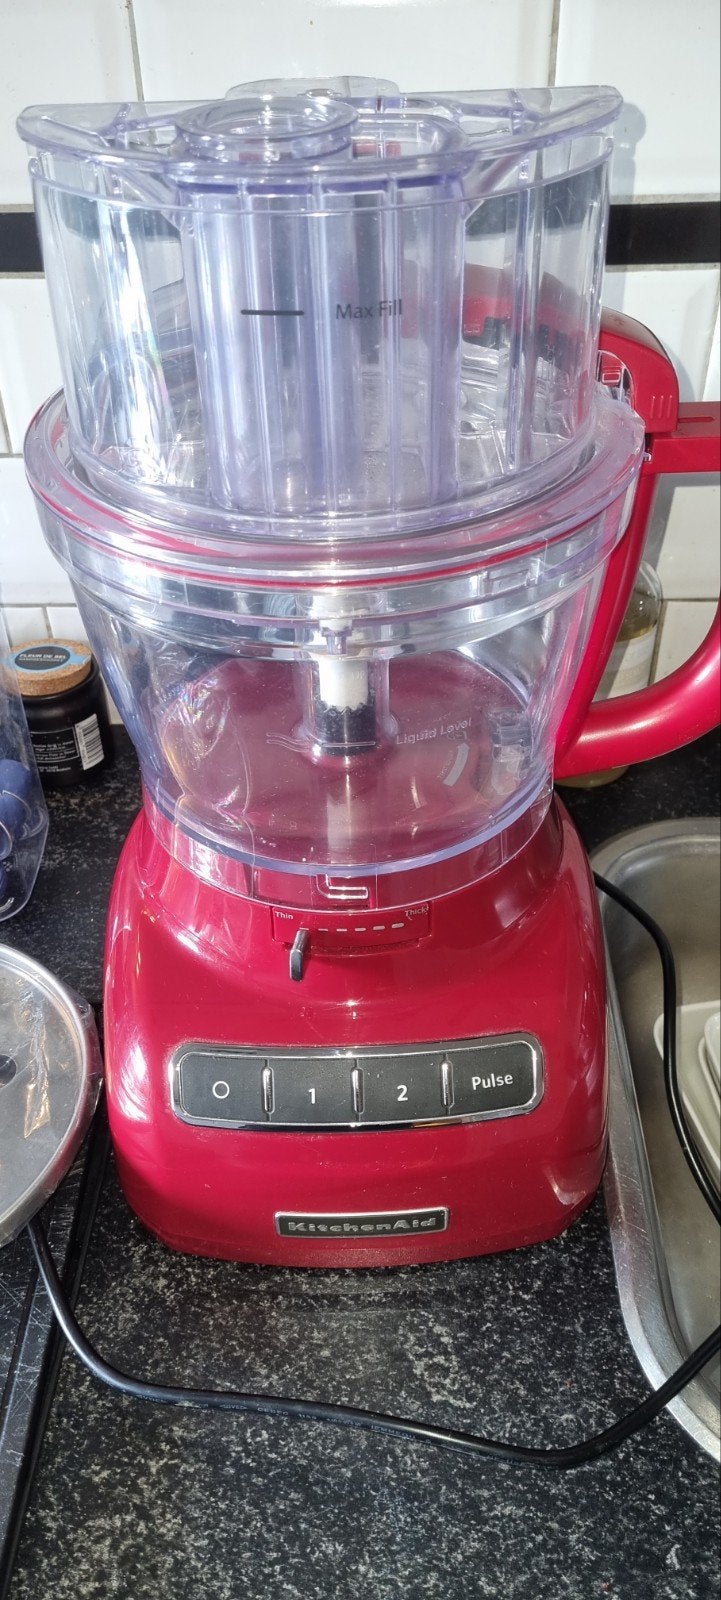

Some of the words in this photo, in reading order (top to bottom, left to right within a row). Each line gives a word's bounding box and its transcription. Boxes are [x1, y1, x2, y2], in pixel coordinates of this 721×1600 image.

[335, 303, 374, 320] Max
[378, 299, 403, 318] Fill
[396, 728, 437, 745] Liquid
[440, 717, 472, 736] Level
[274, 910, 294, 920] Thin
[404, 905, 429, 918] Thick
[471, 1072, 514, 1091] Pulse
[308, 1087, 317, 1105] 1
[396, 1084, 409, 1103] 2
[288, 1217, 437, 1232] KitchenAid
